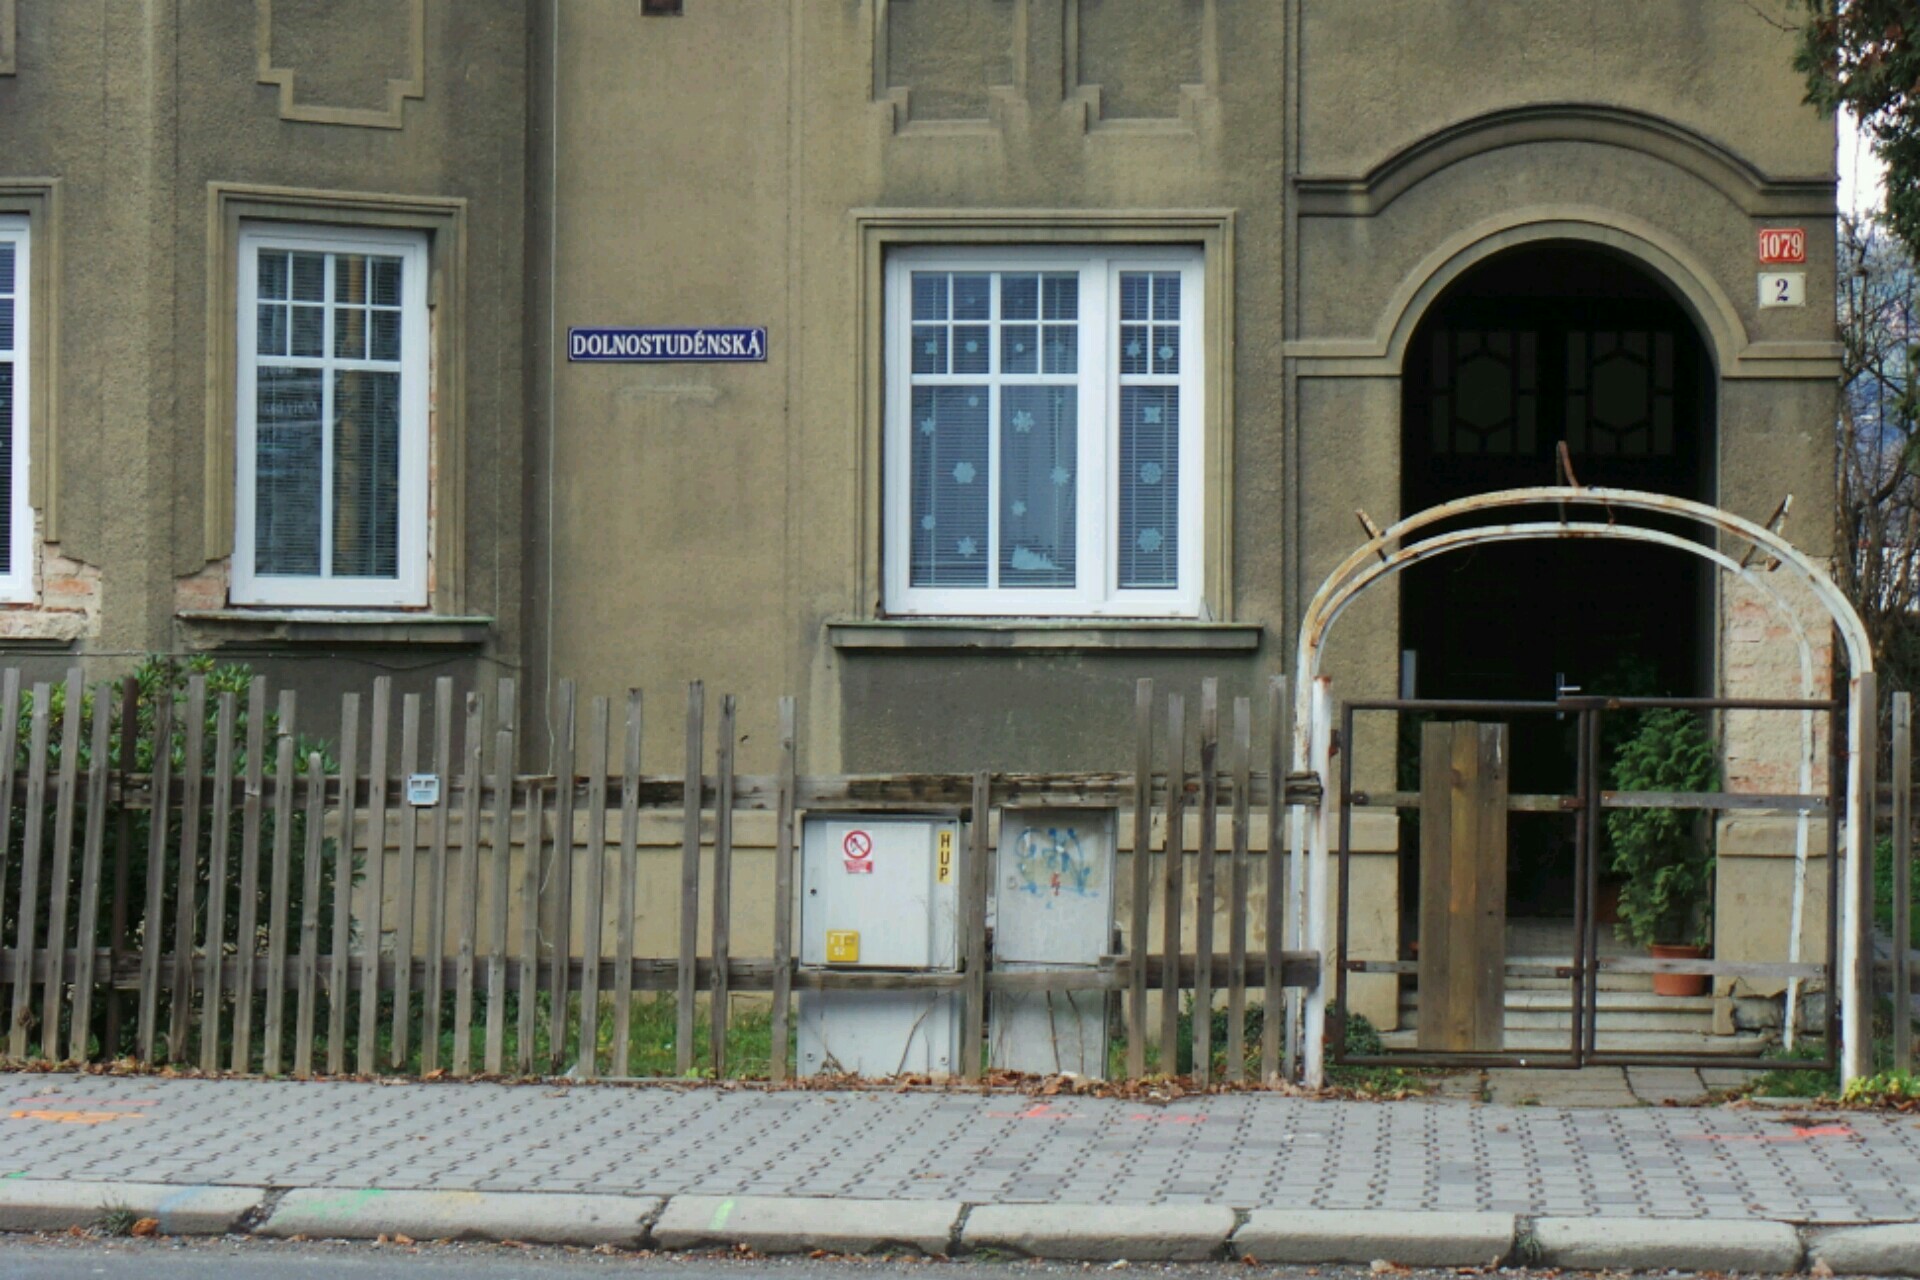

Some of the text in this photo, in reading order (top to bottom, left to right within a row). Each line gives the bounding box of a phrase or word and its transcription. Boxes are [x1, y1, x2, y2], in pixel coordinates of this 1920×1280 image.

[1763, 233, 1800, 258] 1079
[1776, 278, 1789, 301] 2
[573, 331, 761, 357] DOLNOSTUDÉNSKÁ
[939, 833, 950, 881] HUP
